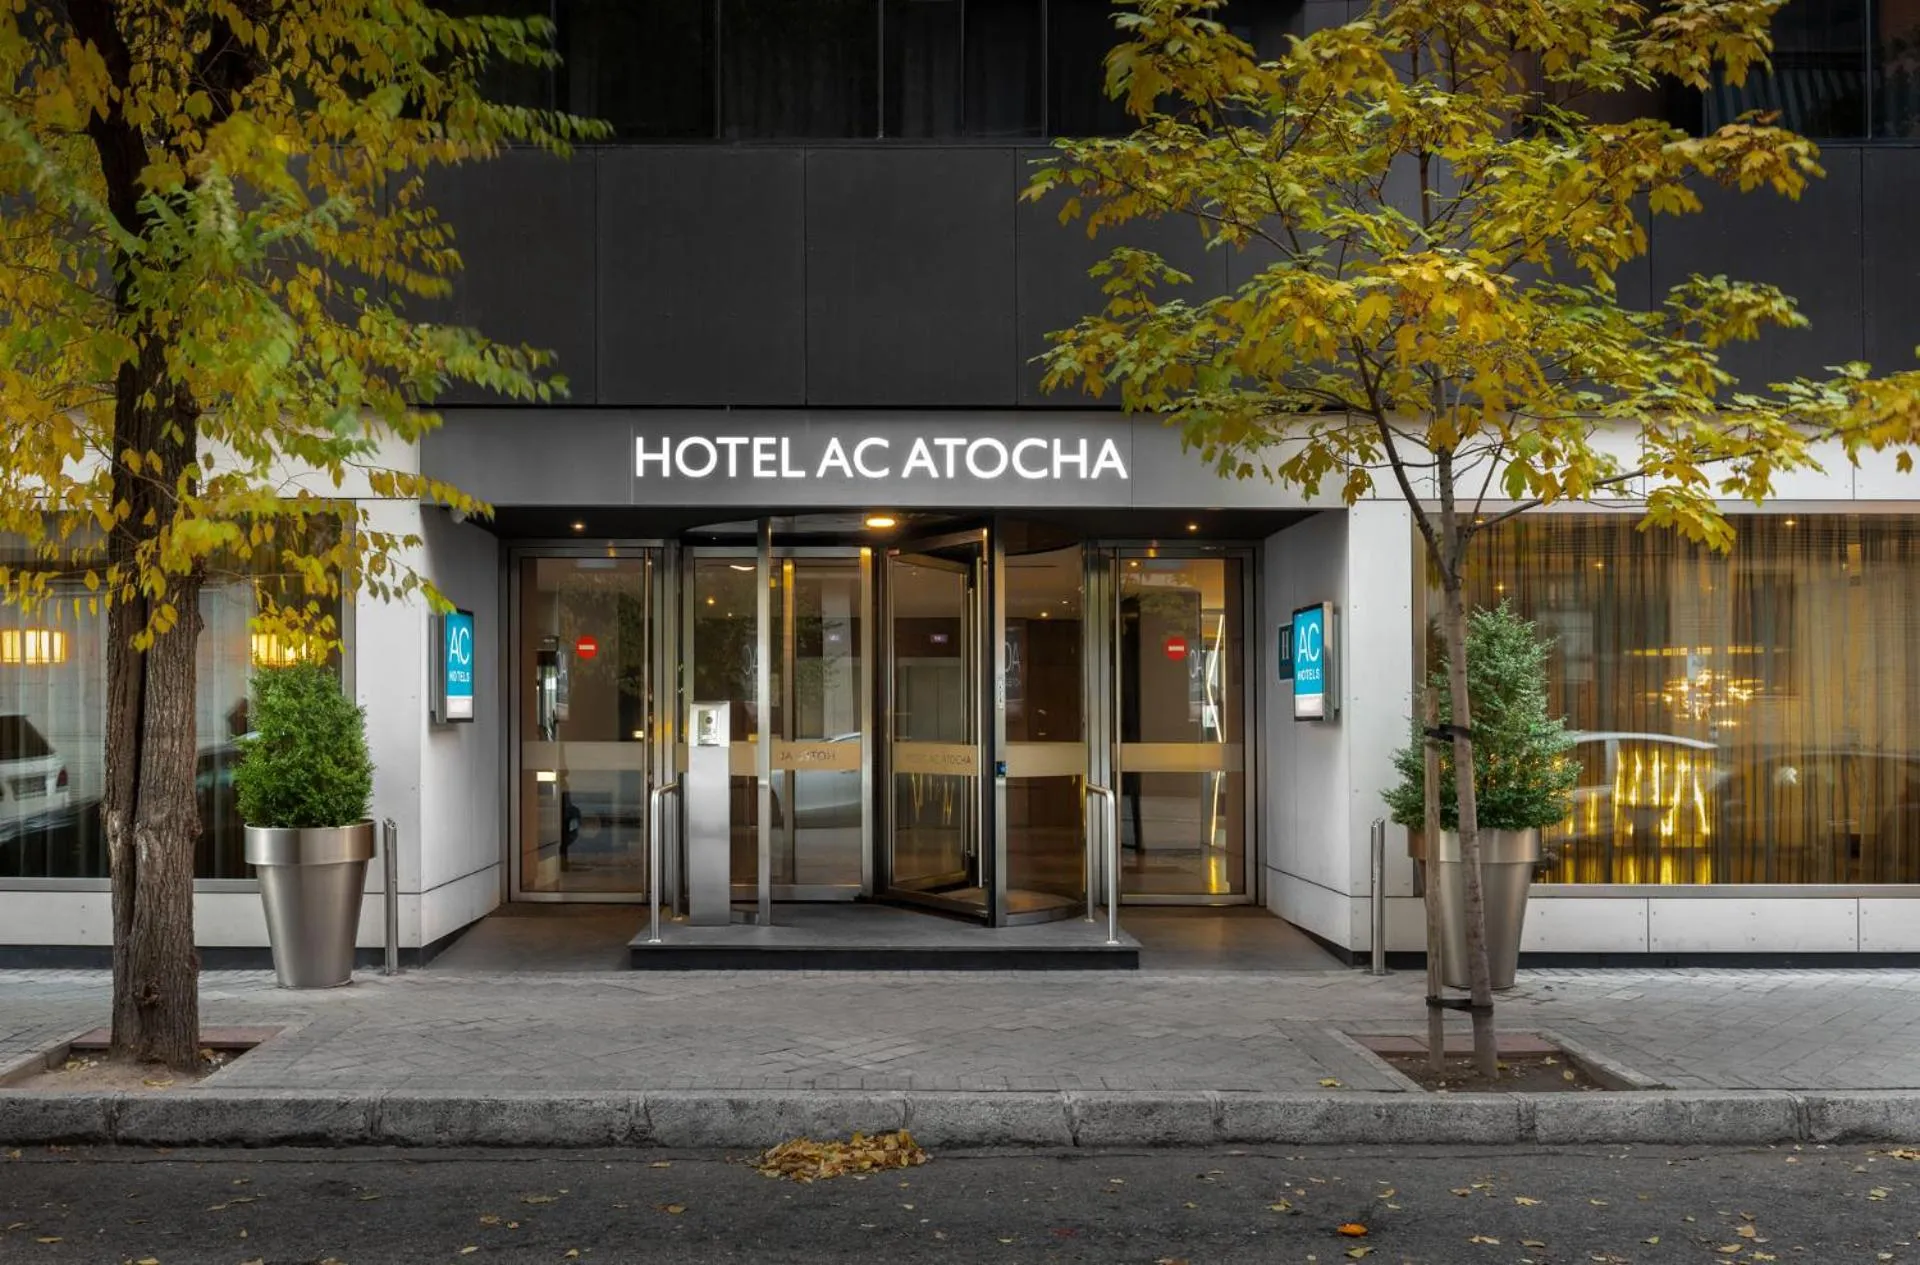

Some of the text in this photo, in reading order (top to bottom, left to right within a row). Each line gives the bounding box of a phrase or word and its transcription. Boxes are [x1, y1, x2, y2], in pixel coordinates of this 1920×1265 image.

[635, 437, 1128, 479] HOTEL AC ATOCHA
[449, 627, 470, 665] AC
[1298, 623, 1320, 663] AC
[449, 670, 470, 682] HOTELS
[1298, 669, 1321, 680] HOTELS
